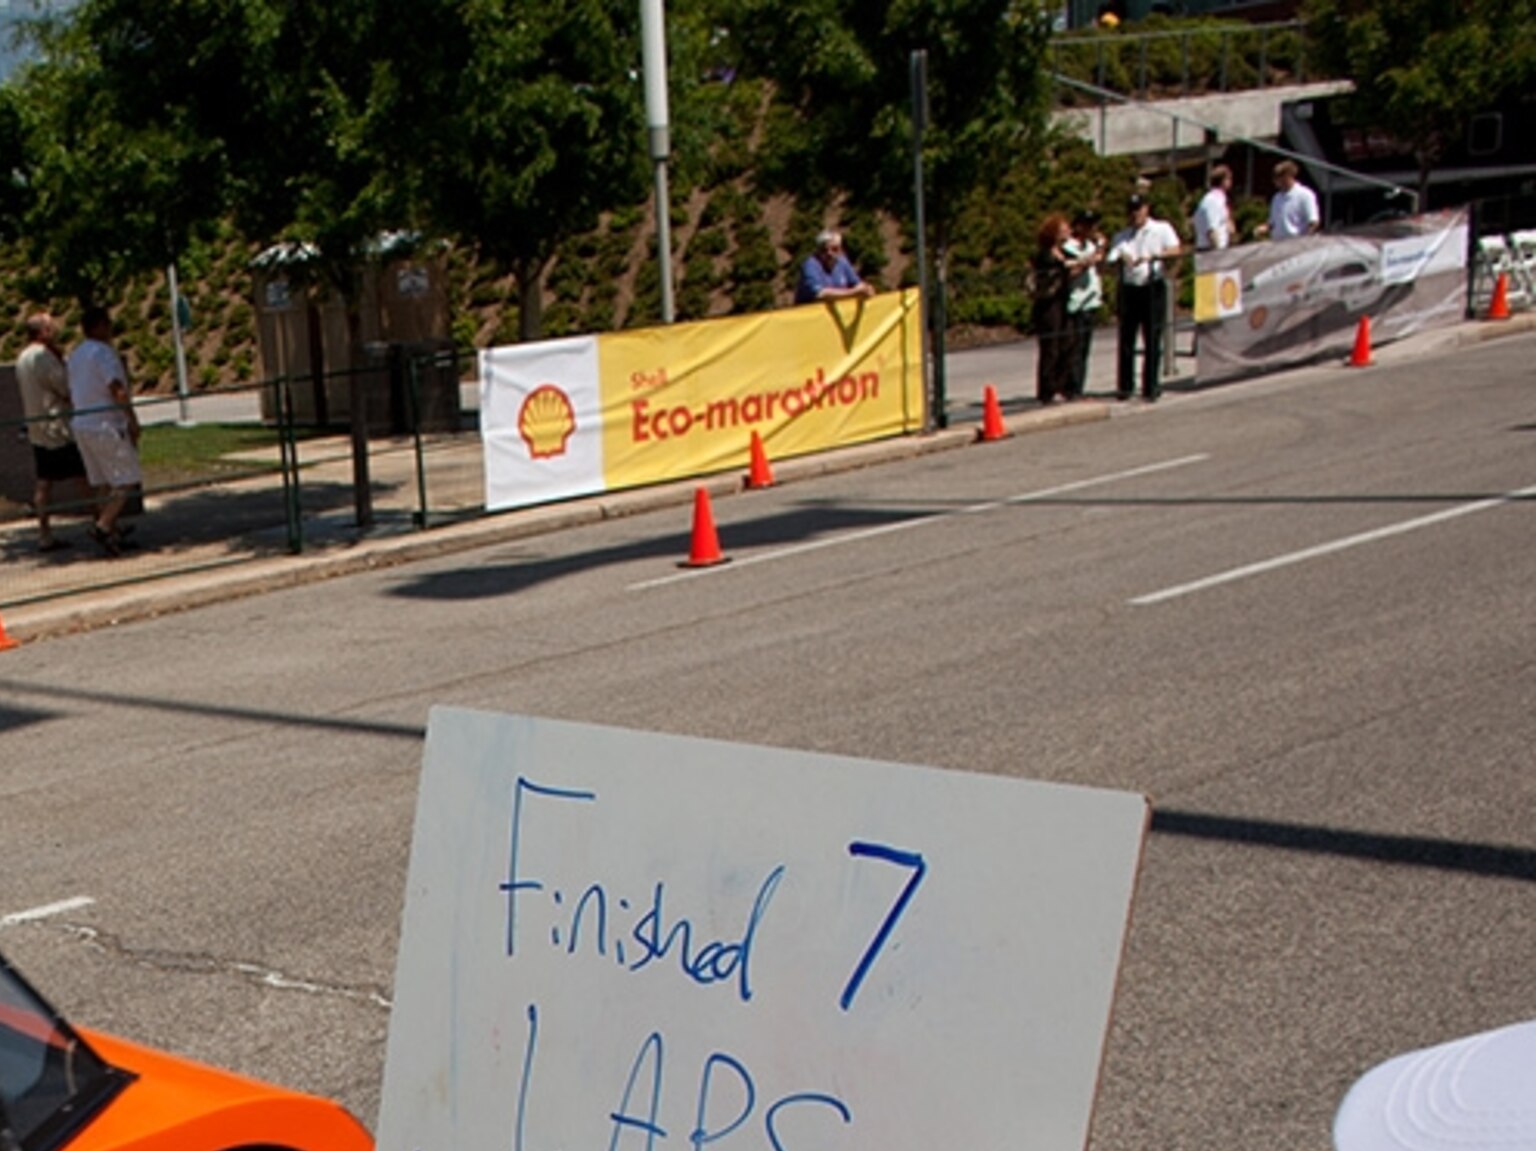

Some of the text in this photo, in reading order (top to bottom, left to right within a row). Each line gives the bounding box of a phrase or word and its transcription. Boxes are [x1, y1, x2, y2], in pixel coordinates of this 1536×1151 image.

[632, 367, 879, 442] Eco-marathon
[498, 776, 927, 1011] Finished 7
